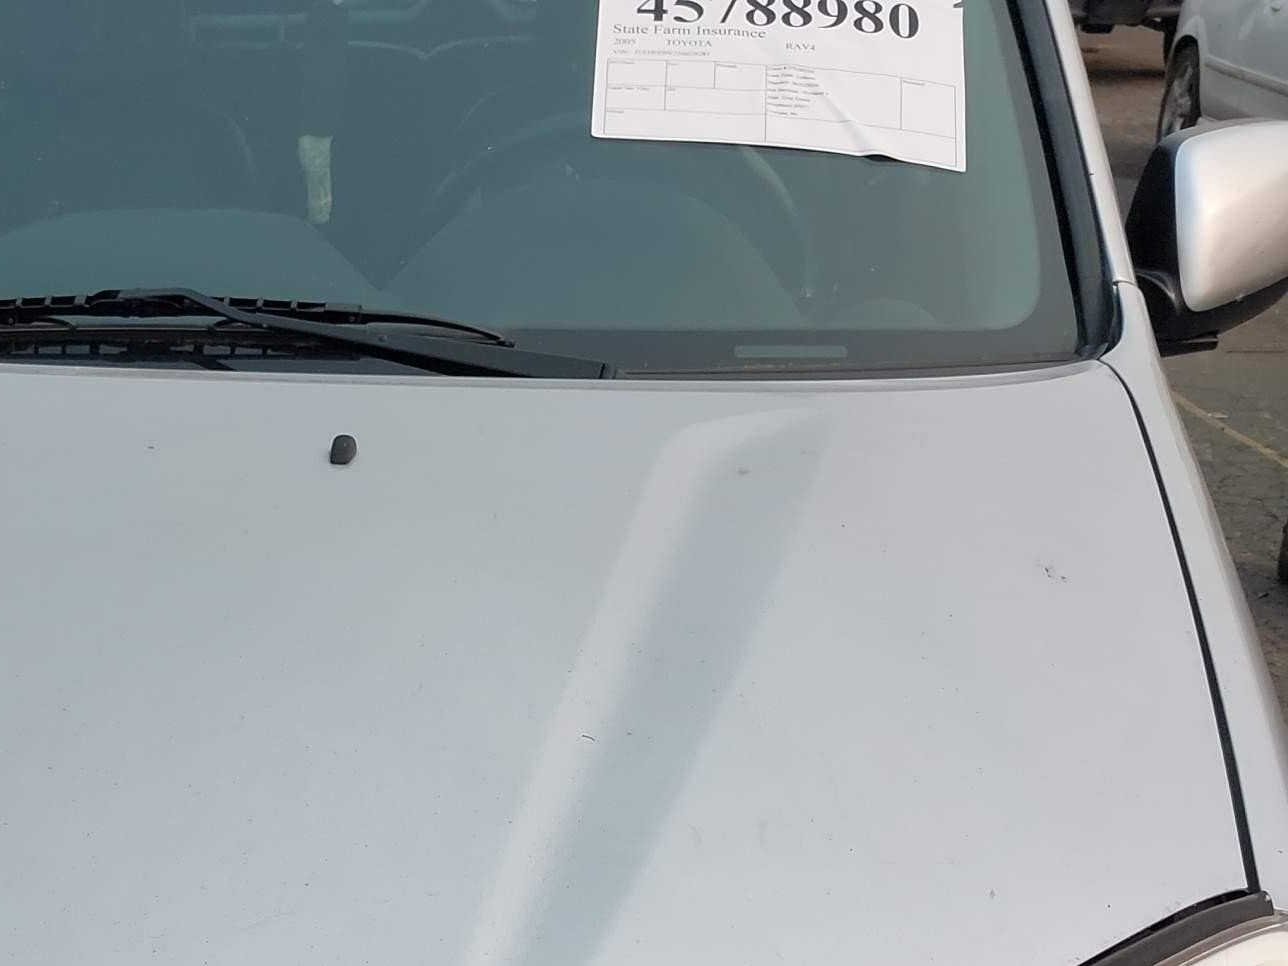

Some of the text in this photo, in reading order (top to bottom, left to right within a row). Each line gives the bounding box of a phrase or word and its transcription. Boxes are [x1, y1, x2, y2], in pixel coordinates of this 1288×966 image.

[612, 24, 767, 39] State Farm Insurance
[667, 39, 712, 47] TOYOTA
[785, 43, 816, 51] RAV4
